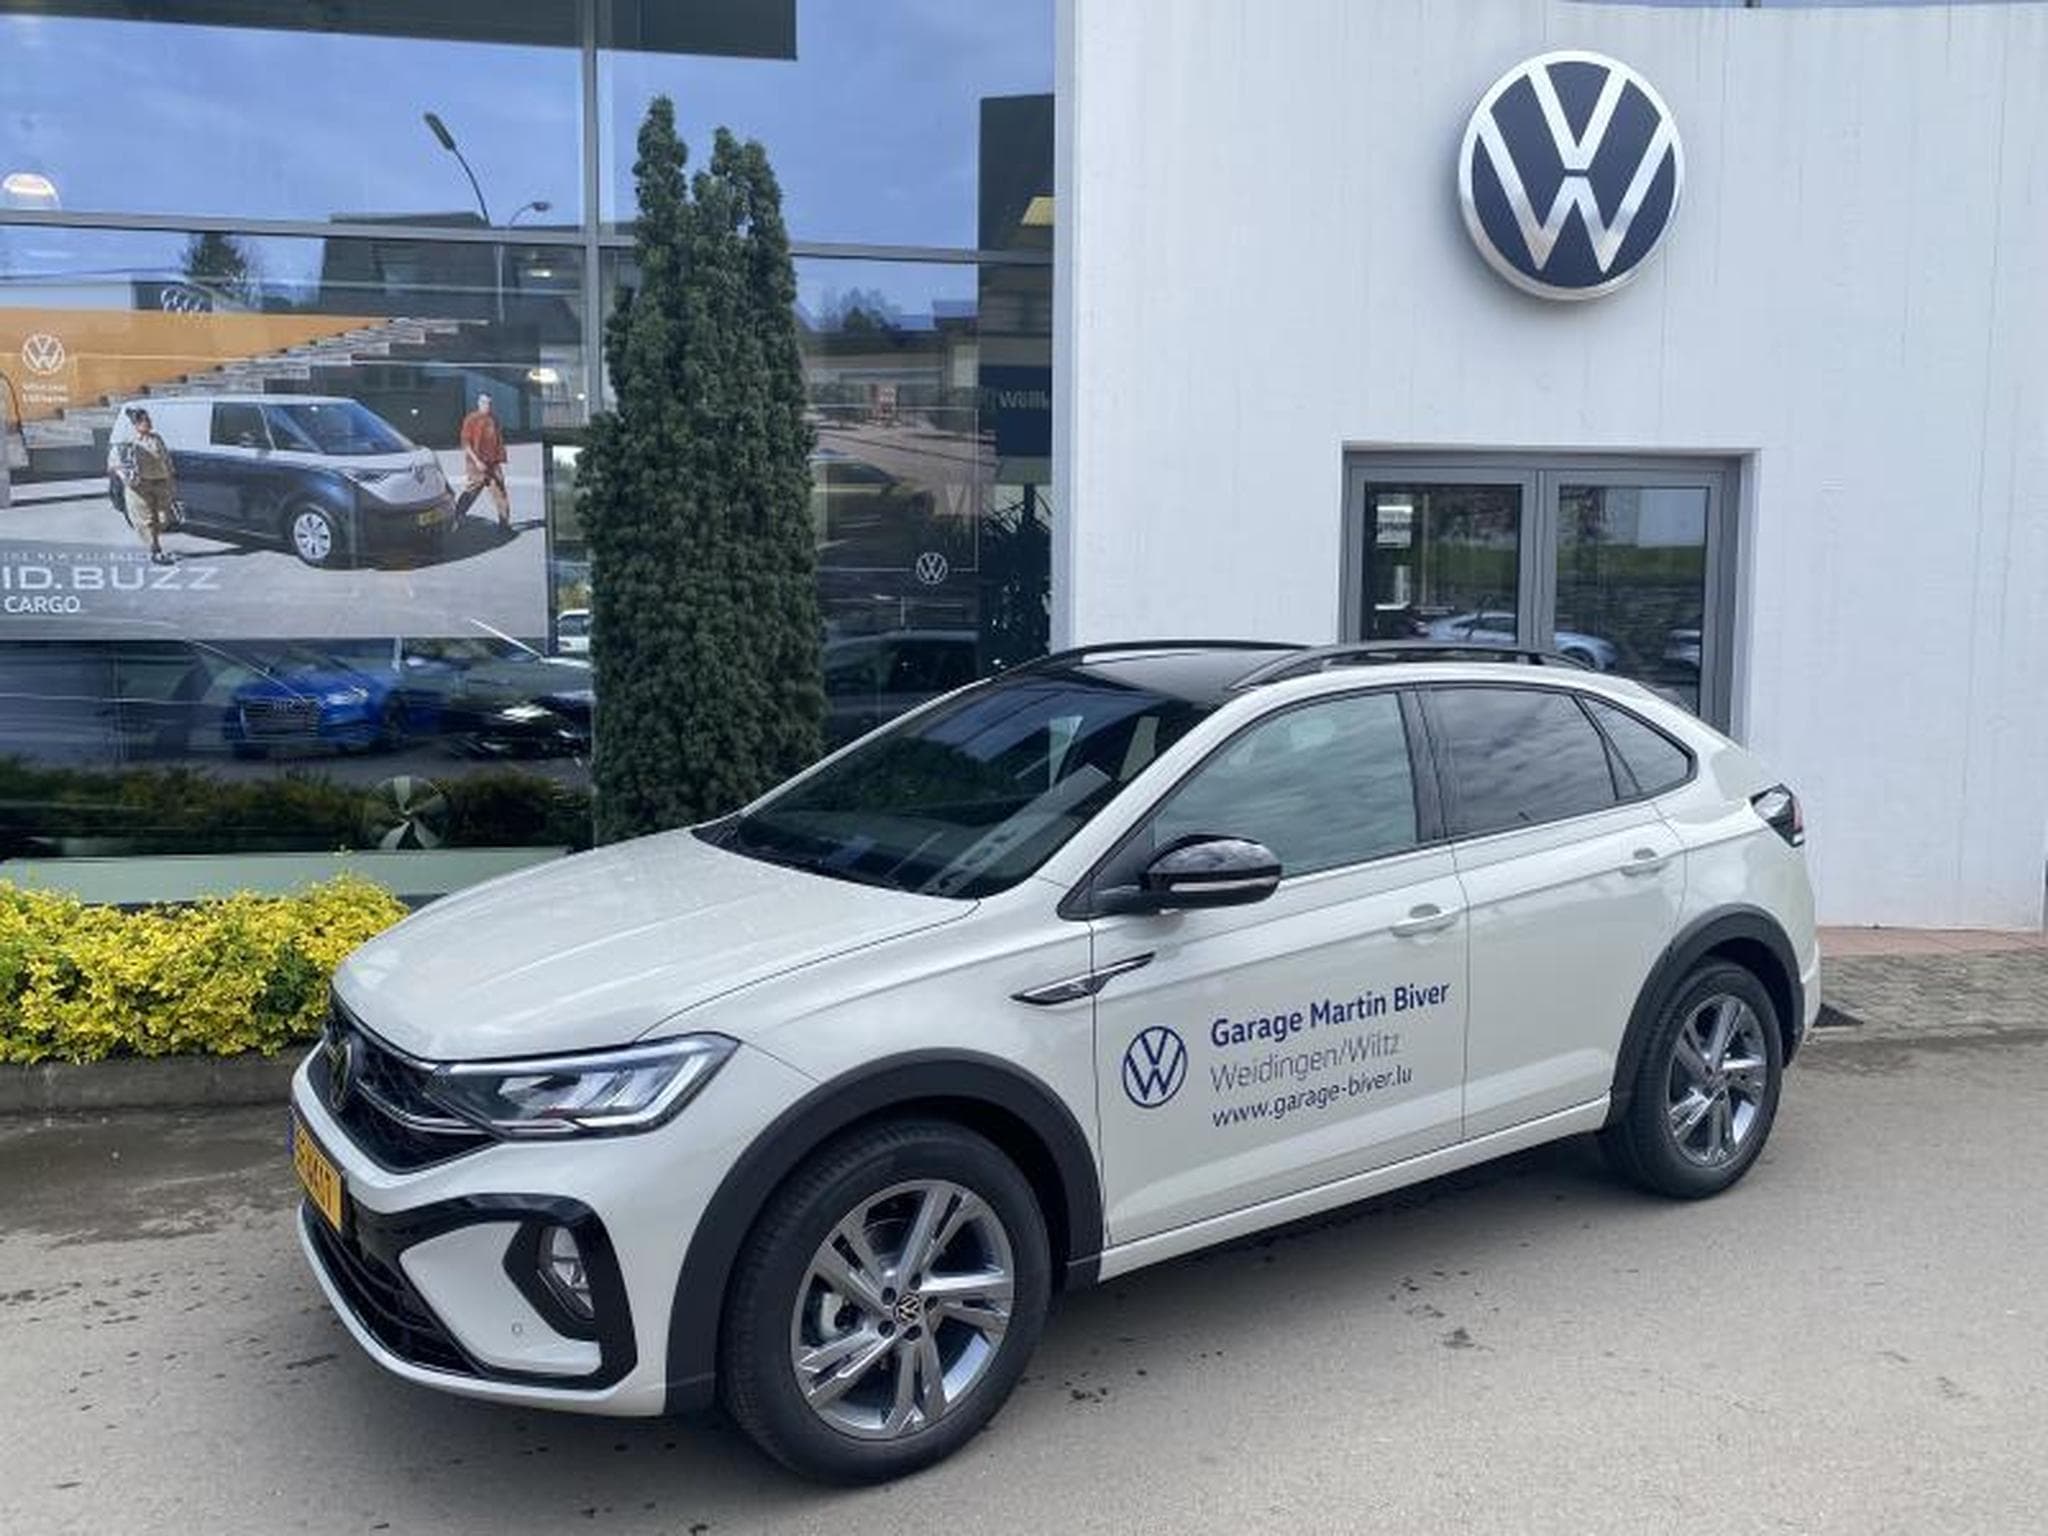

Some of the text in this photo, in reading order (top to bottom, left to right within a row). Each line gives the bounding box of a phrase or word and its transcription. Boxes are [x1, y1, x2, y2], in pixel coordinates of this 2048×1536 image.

[4, 595, 81, 614] CARGO
[1210, 982, 1450, 1048] Garage Martin Biver
[1210, 1031, 1402, 1093] Weidingen/Wiltz
[1212, 1064, 1413, 1128] www.garage-biver.lu
